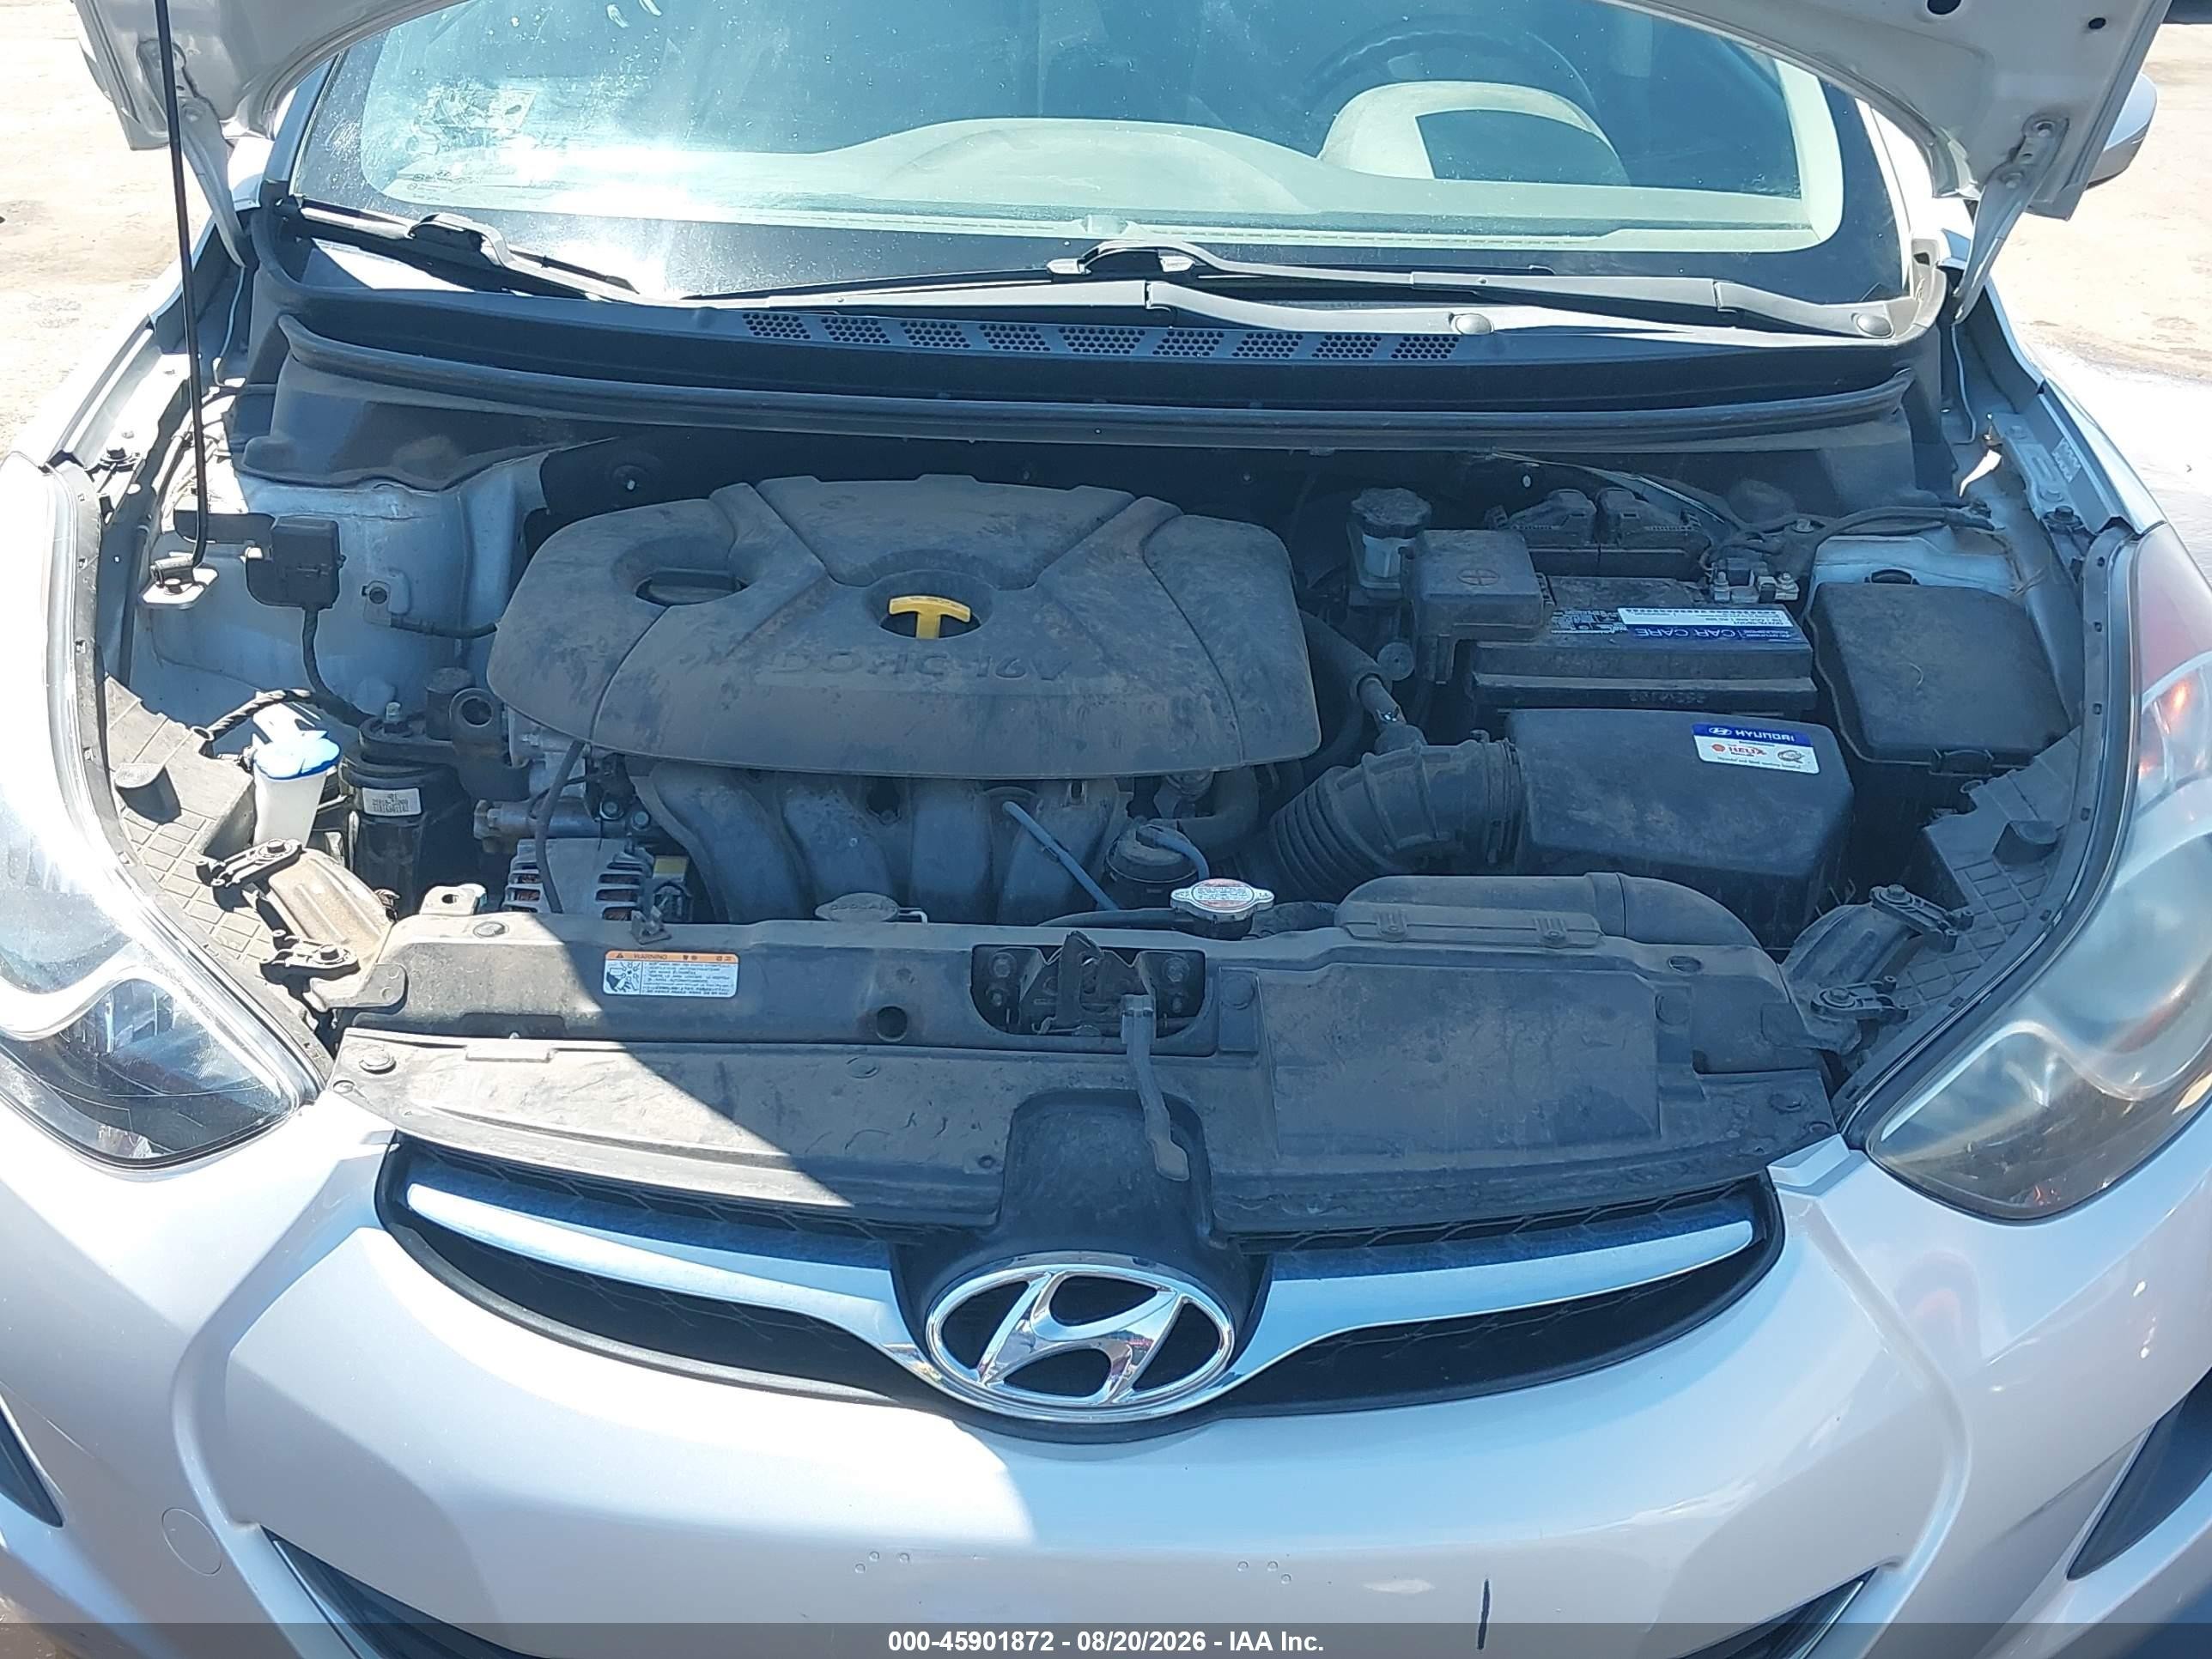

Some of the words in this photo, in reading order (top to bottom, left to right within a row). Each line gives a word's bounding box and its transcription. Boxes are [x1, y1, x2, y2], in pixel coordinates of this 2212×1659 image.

[1635, 627, 1689, 637] CARE
[1694, 628, 1736, 638] CAR
[1735, 729, 1795, 742] HYUNDAI
